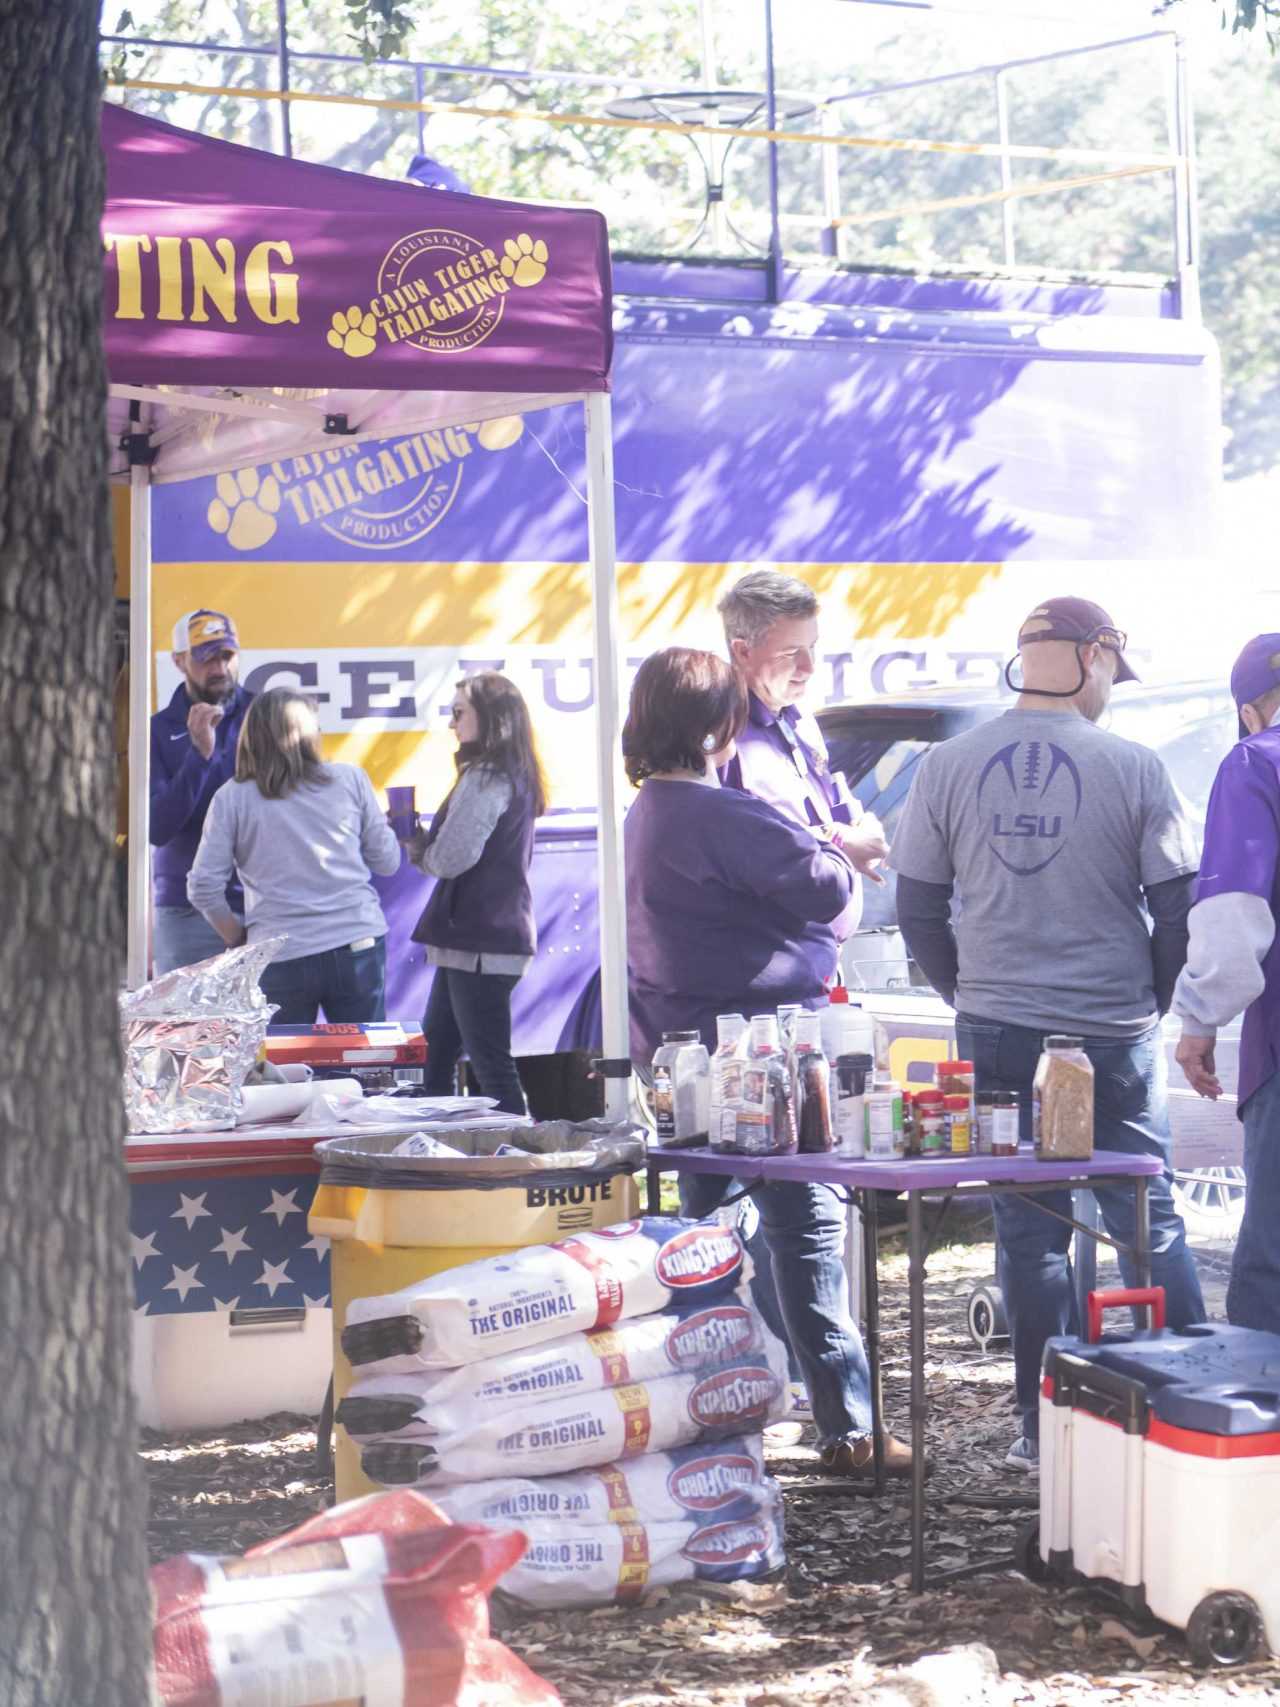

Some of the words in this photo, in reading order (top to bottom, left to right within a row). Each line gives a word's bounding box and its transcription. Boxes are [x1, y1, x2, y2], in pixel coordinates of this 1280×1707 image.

[393, 235, 470, 265] LOUISIANA
[104, 232, 300, 325] TING
[370, 279, 431, 318] CAJUN
[434, 249, 499, 289] TIGER
[379, 270, 511, 343] TAILGATING
[420, 309, 496, 349] PRODUCTION
[284, 427, 472, 525] TAILGATING
[341, 483, 449, 539] PRODUCTION
[993, 814, 1061, 838] LSU
[527, 1181, 612, 1208] BRUTE
[469, 1313, 499, 1335] THE
[502, 1294, 576, 1328] ORIGINAL
[530, 1418, 605, 1447] ORIGINAL
[576, 1543, 604, 1562] THE
